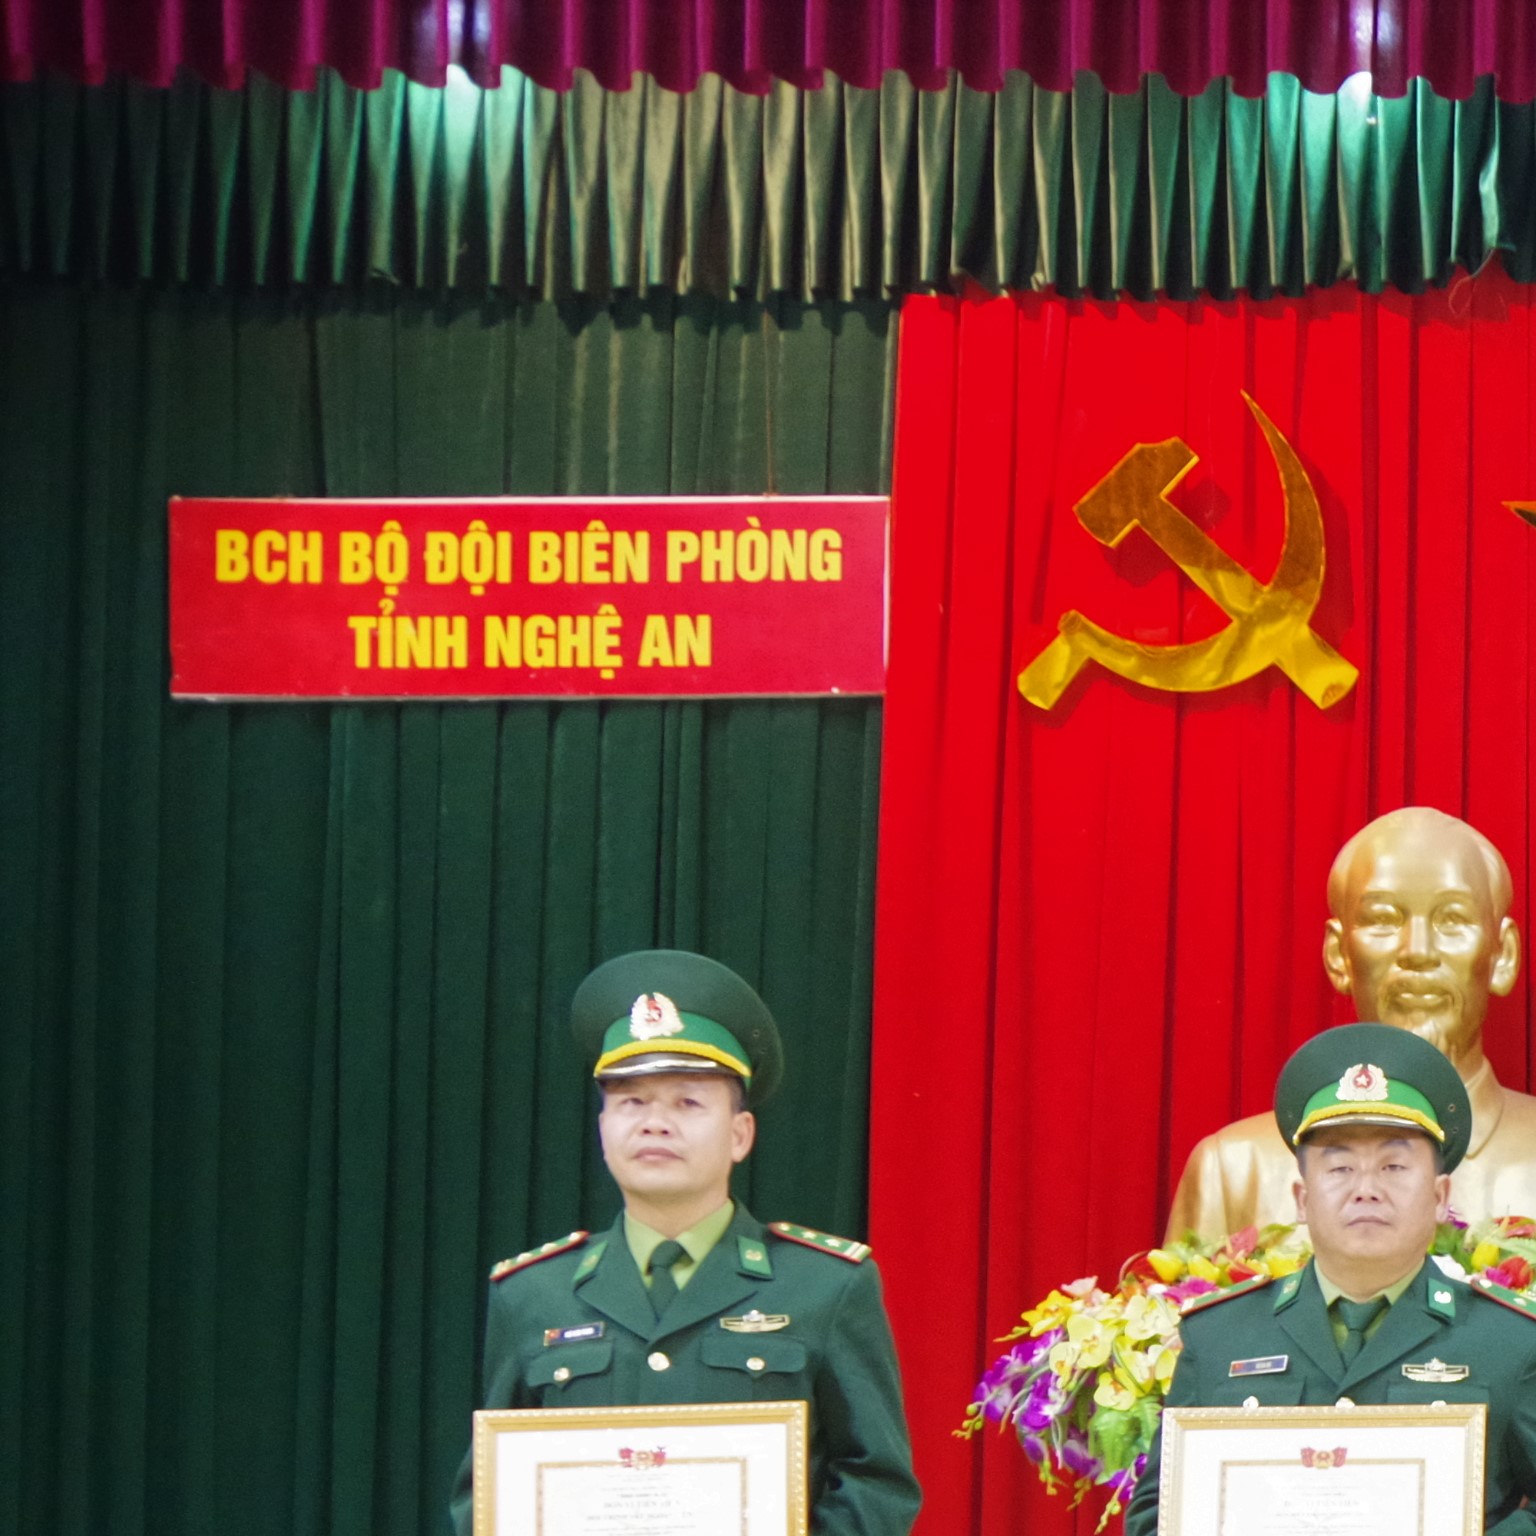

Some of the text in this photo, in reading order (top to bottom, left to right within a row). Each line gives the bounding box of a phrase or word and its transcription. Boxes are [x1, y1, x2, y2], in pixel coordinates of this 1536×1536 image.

[216, 516, 842, 596] BCH BỘ ĐỘI BIÊN PHÒNG
[347, 598, 712, 679] TỈNH NGHỆ AN
